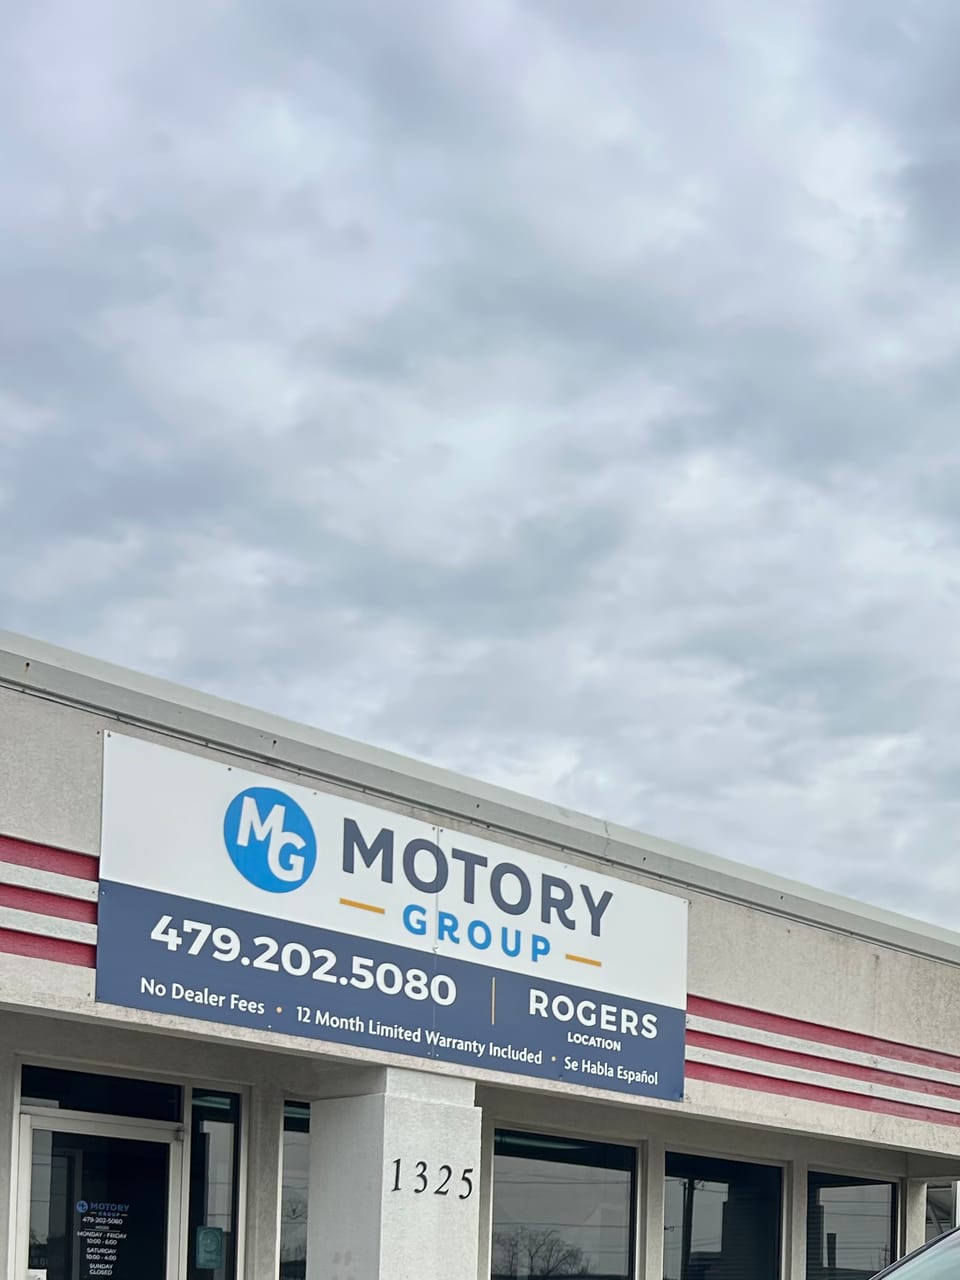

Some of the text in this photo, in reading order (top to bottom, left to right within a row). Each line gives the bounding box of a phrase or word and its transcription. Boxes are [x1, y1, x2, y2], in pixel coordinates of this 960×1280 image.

[236, 796, 613, 937] MG MOTORY
[402, 904, 551, 962] GROUP
[150, 914, 457, 1006] 479.202.5080
[140, 977, 265, 1014] No Dealer Fees
[529, 988, 658, 1039] ROGERS
[297, 1006, 542, 1065] 12 Month Limited Warranty Included
[567, 1032, 621, 1051] LOCATION
[564, 1056, 658, 1085] Se Habla Español
[391, 1158, 473, 1199] 1325
[90, 1203, 130, 1212] MOTORY
